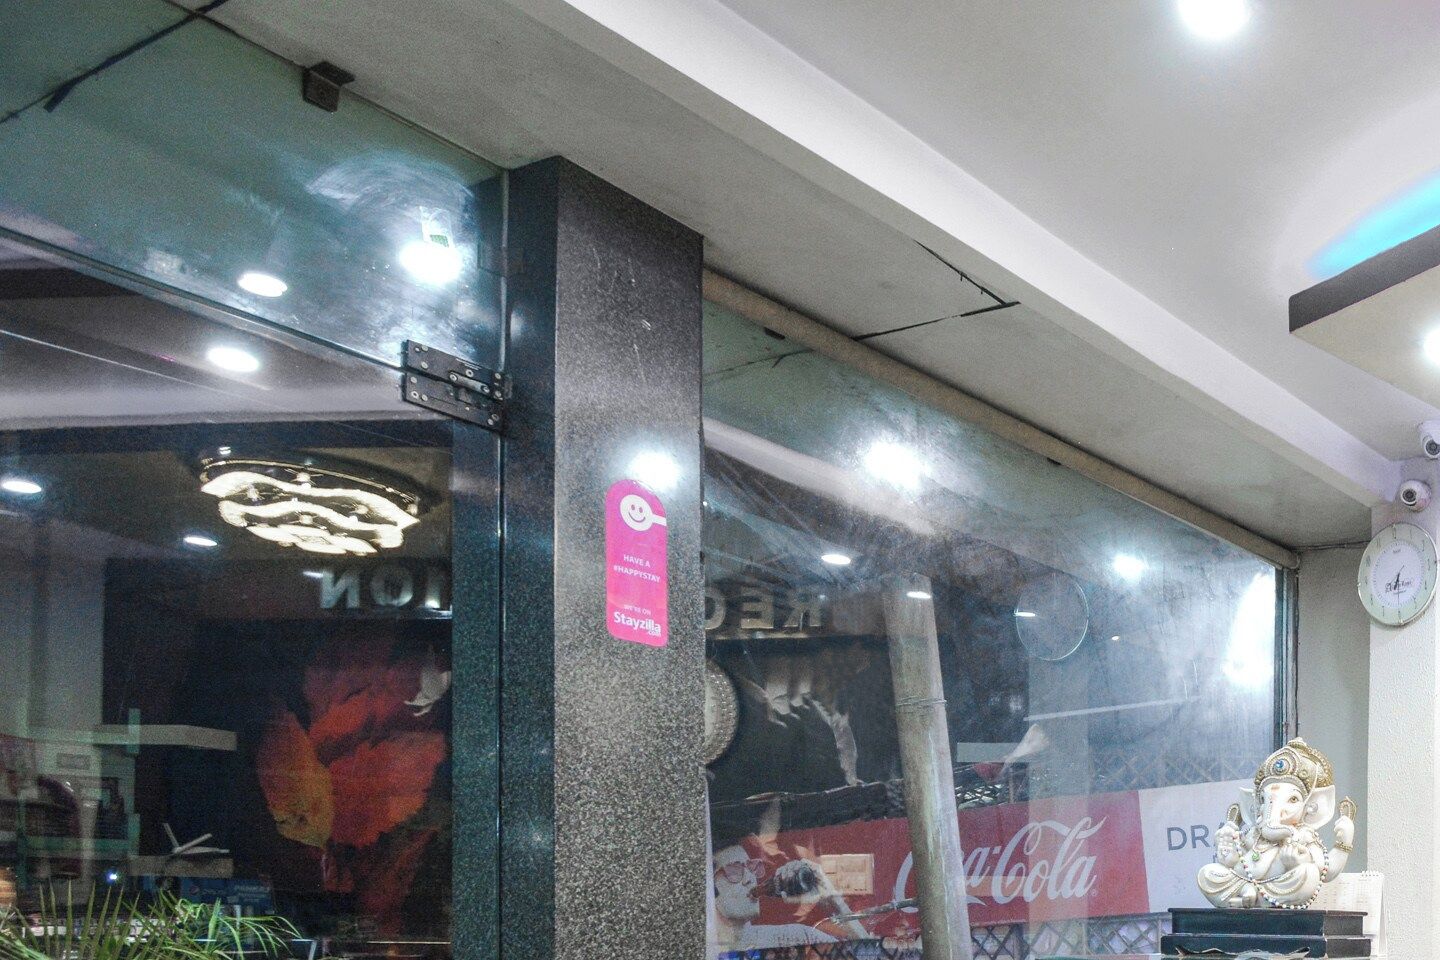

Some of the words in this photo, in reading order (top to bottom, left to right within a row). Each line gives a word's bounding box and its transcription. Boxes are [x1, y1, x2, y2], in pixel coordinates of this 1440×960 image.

[623, 553, 644, 567] HAVE
[613, 564, 661, 583] #HAPPYSTAY
[613, 611, 662, 634] Stayzilla
